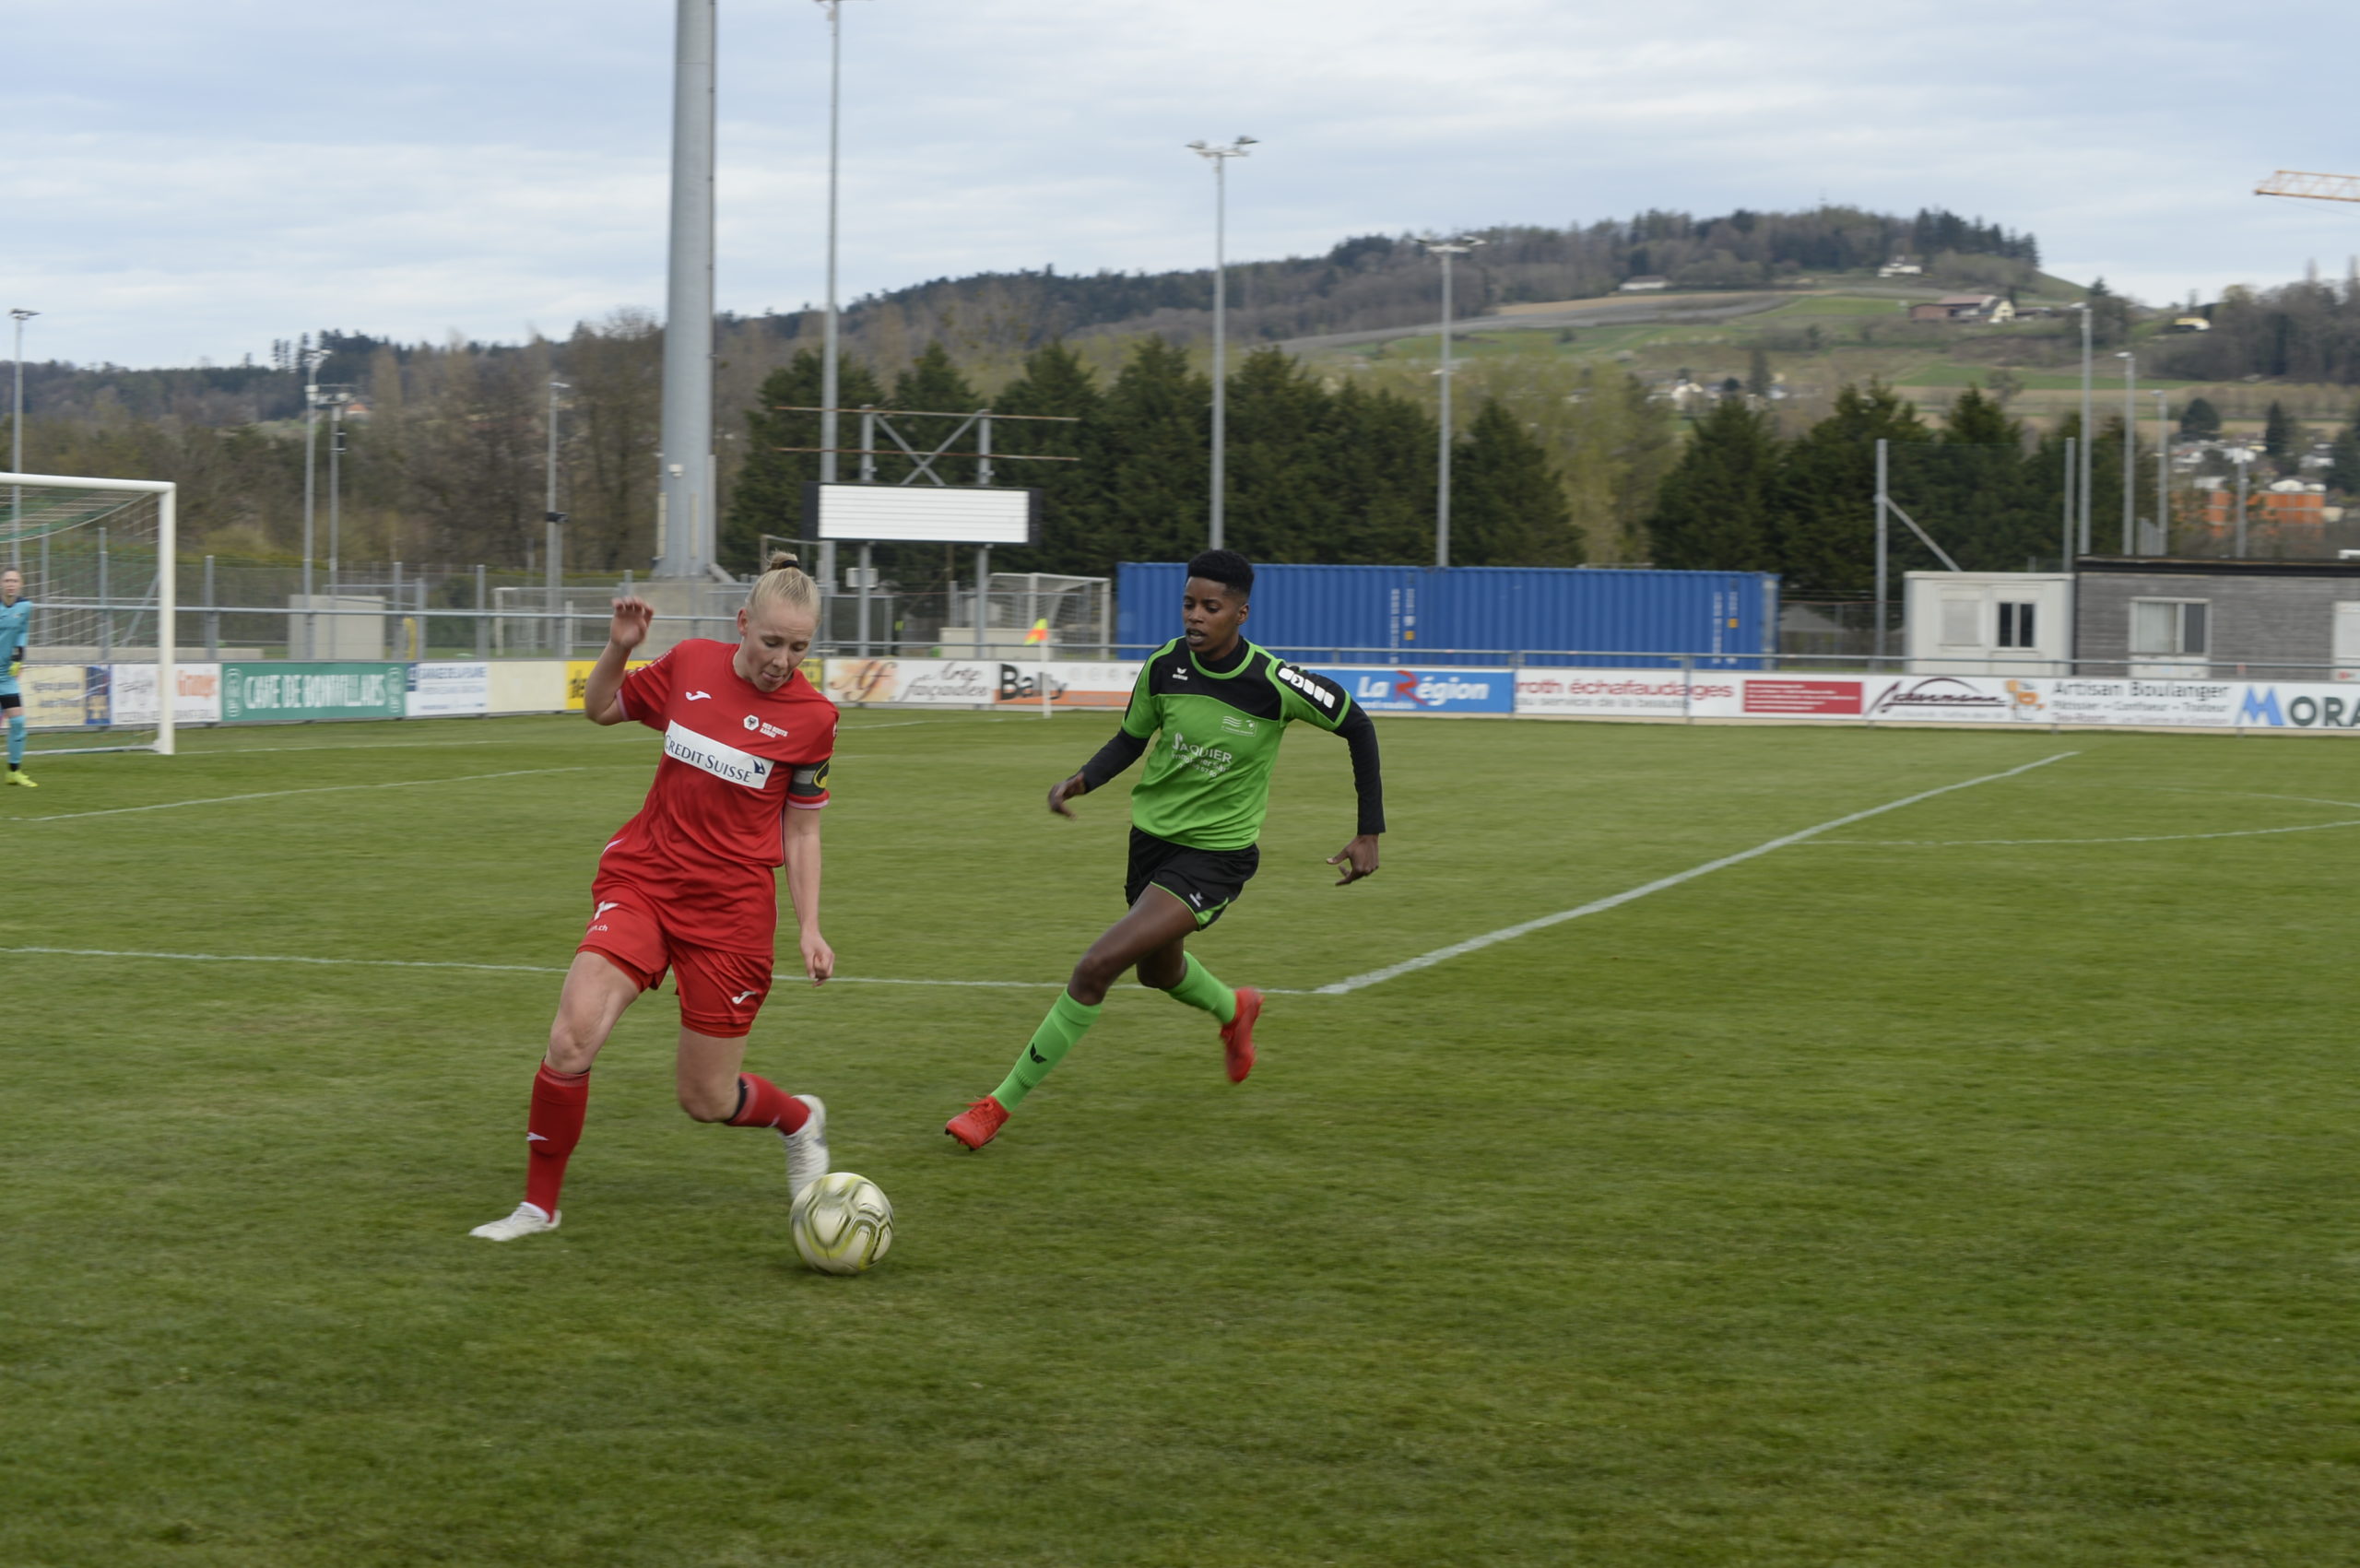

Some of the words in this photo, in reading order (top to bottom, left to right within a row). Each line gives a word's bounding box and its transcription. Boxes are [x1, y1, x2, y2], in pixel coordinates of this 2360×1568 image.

[243, 675, 281, 709] CAVE
[282, 675, 302, 708] DE
[1356, 676, 1390, 698] La
[1394, 669, 1490, 707] Région
[1516, 678, 1563, 694] roth
[1569, 678, 1734, 701] échafaudages
[2052, 680, 2124, 696] Artisan
[2130, 681, 2231, 701] Boulanger
[665, 734, 705, 765] CREDIT
[705, 754, 752, 784] SUISSE
